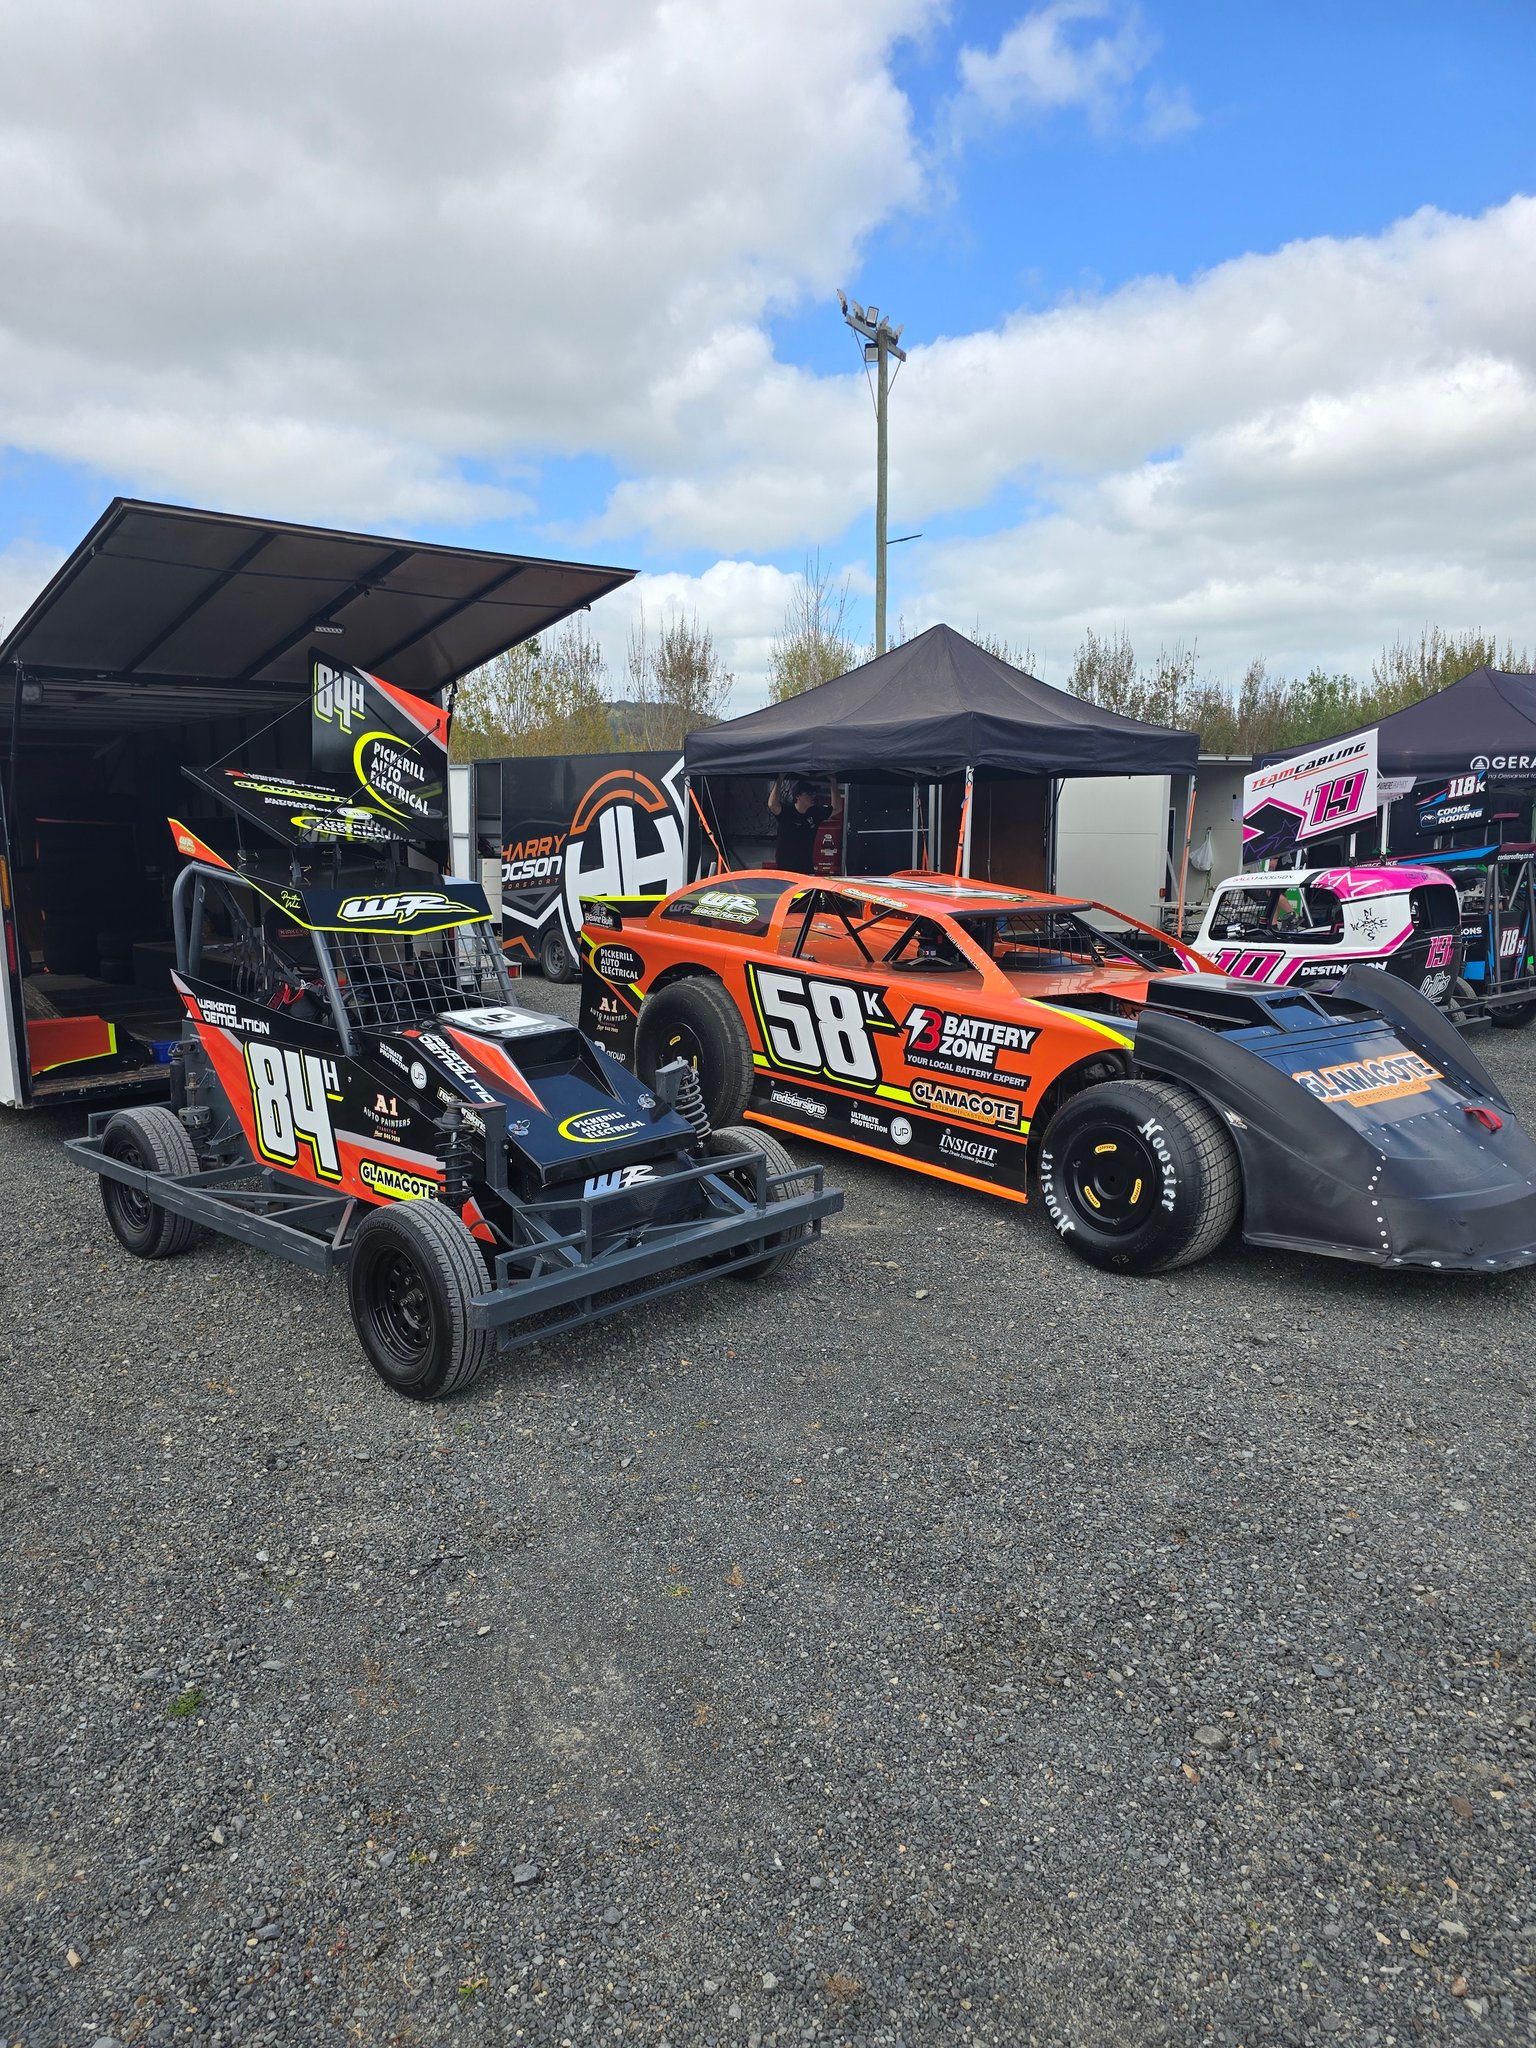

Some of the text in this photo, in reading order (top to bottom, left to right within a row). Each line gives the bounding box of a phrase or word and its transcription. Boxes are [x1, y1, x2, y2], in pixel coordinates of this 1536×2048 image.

[374, 741, 425, 782] PICKERILL
[1437, 804, 1471, 817] COOKE
[1438, 811, 1482, 824] ROOFING
[600, 949, 633, 972] PICKERILL
[600, 958, 620, 967] AUTO
[600, 966, 639, 980] ELECTRICAL
[197, 998, 237, 1014] WAIKATO
[599, 997, 618, 1013] A1
[202, 1010, 270, 1035] DEMOLITION
[943, 1015, 1035, 1050] BATTERY
[939, 1035, 996, 1064] ZONE
[907, 1054, 1026, 1087] YOUR LOCAL BATTERY EXPERT
[1298, 1055, 1437, 1100] GLAMACOTE
[374, 1094, 399, 1117] A1
[771, 1092, 827, 1115] redstarsigns
[914, 1083, 1016, 1121] GLAMACOTE
[363, 1106, 411, 1128] AUTO PAINTERS
[572, 1111, 626, 1129] PICKERILL
[580, 1121, 610, 1134] AUTO
[850, 1118, 888, 1134] PROTECTION
[851, 1111, 879, 1125] ULTIMATE
[585, 1120, 646, 1139] ELECTRICAL
[893, 1125, 910, 1137] UP
[939, 1134, 998, 1161] INSIGHT
[1137, 1117, 1183, 1212] Hoosier
[362, 1165, 437, 1197] GLAMACOTE
